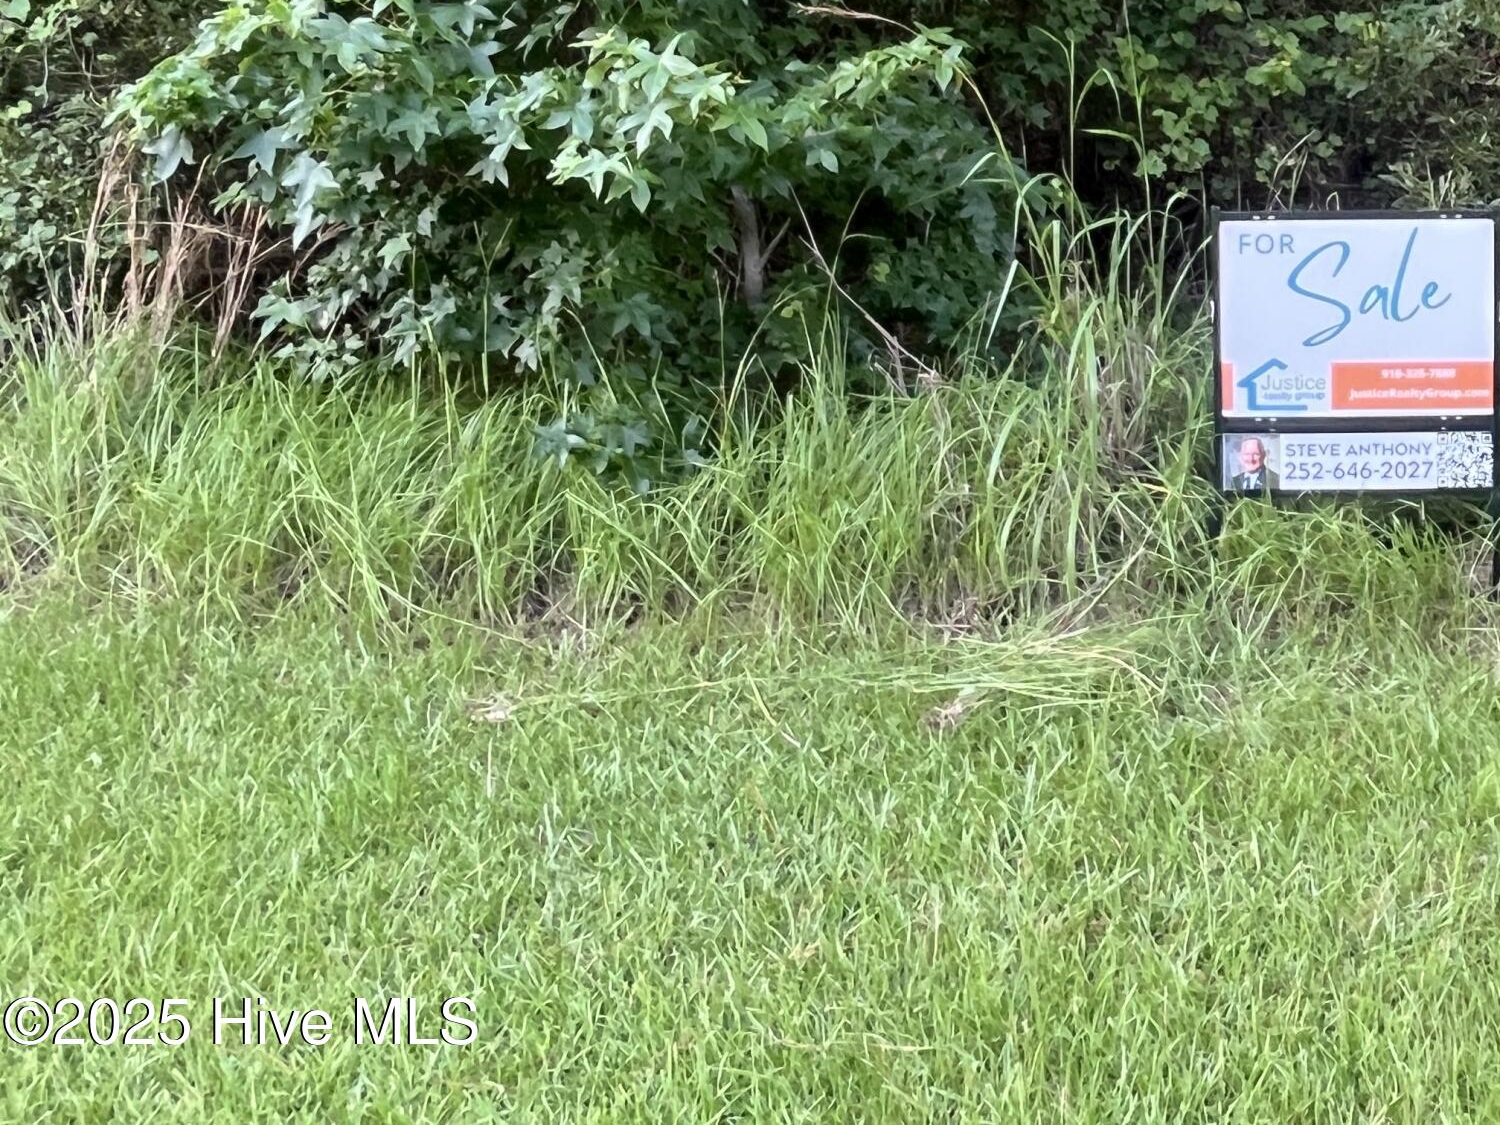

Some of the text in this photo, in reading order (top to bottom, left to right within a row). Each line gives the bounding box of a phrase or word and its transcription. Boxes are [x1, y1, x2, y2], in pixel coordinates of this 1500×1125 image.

[1238, 233, 1296, 255] FOR
[1287, 226, 1452, 347] Sale
[1261, 373, 1327, 391] Justice
[1285, 442, 1433, 457] STEVE ANTHONY
[1284, 461, 1433, 481] 252-646-2027
